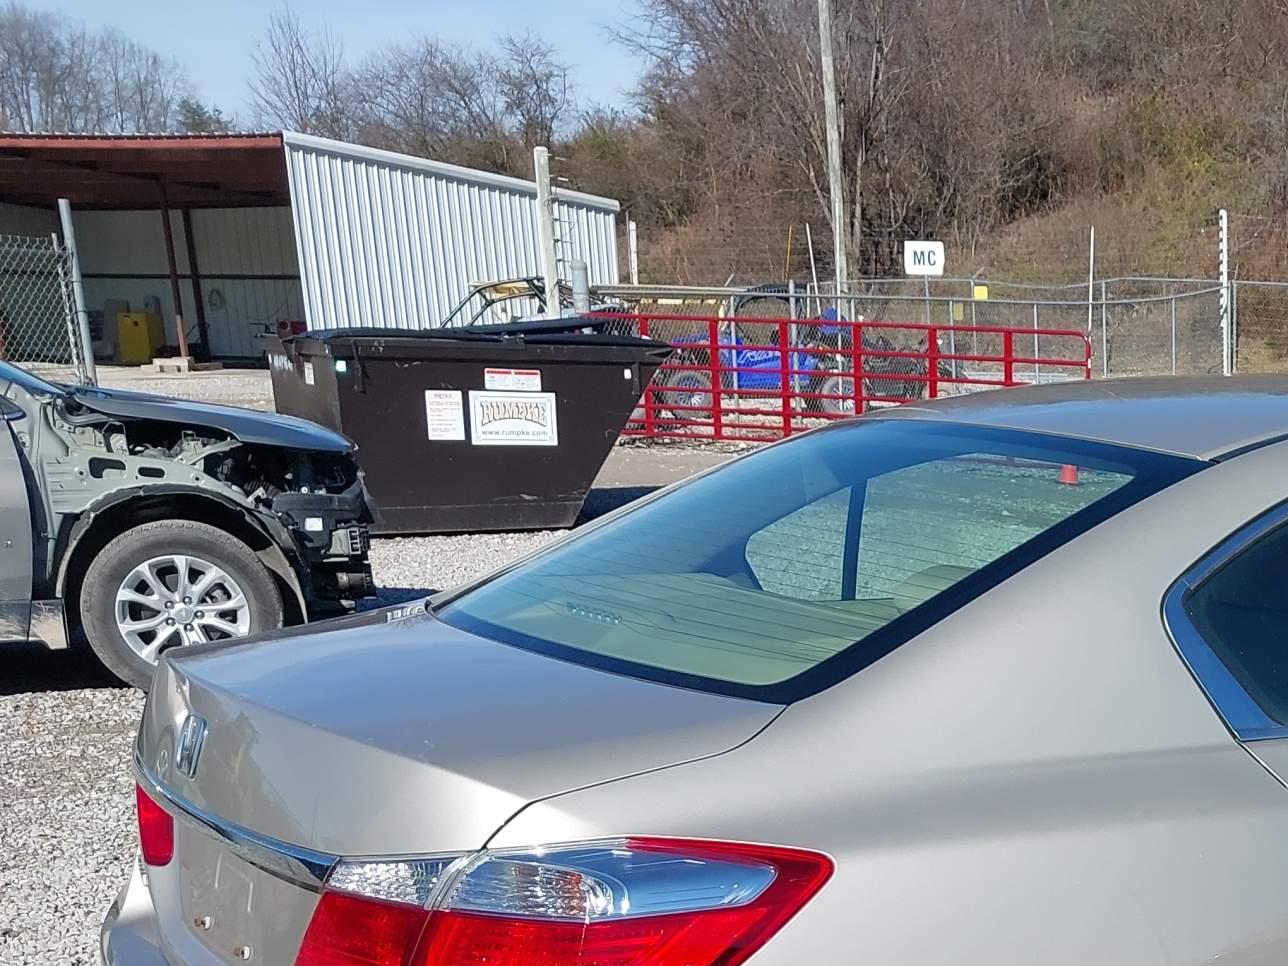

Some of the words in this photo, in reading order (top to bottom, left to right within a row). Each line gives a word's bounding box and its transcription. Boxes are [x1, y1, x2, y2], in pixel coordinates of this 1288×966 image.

[913, 249, 936, 266] MC
[479, 400, 548, 427] RUMPKE
[481, 429, 548, 437] www.rumpke.com
